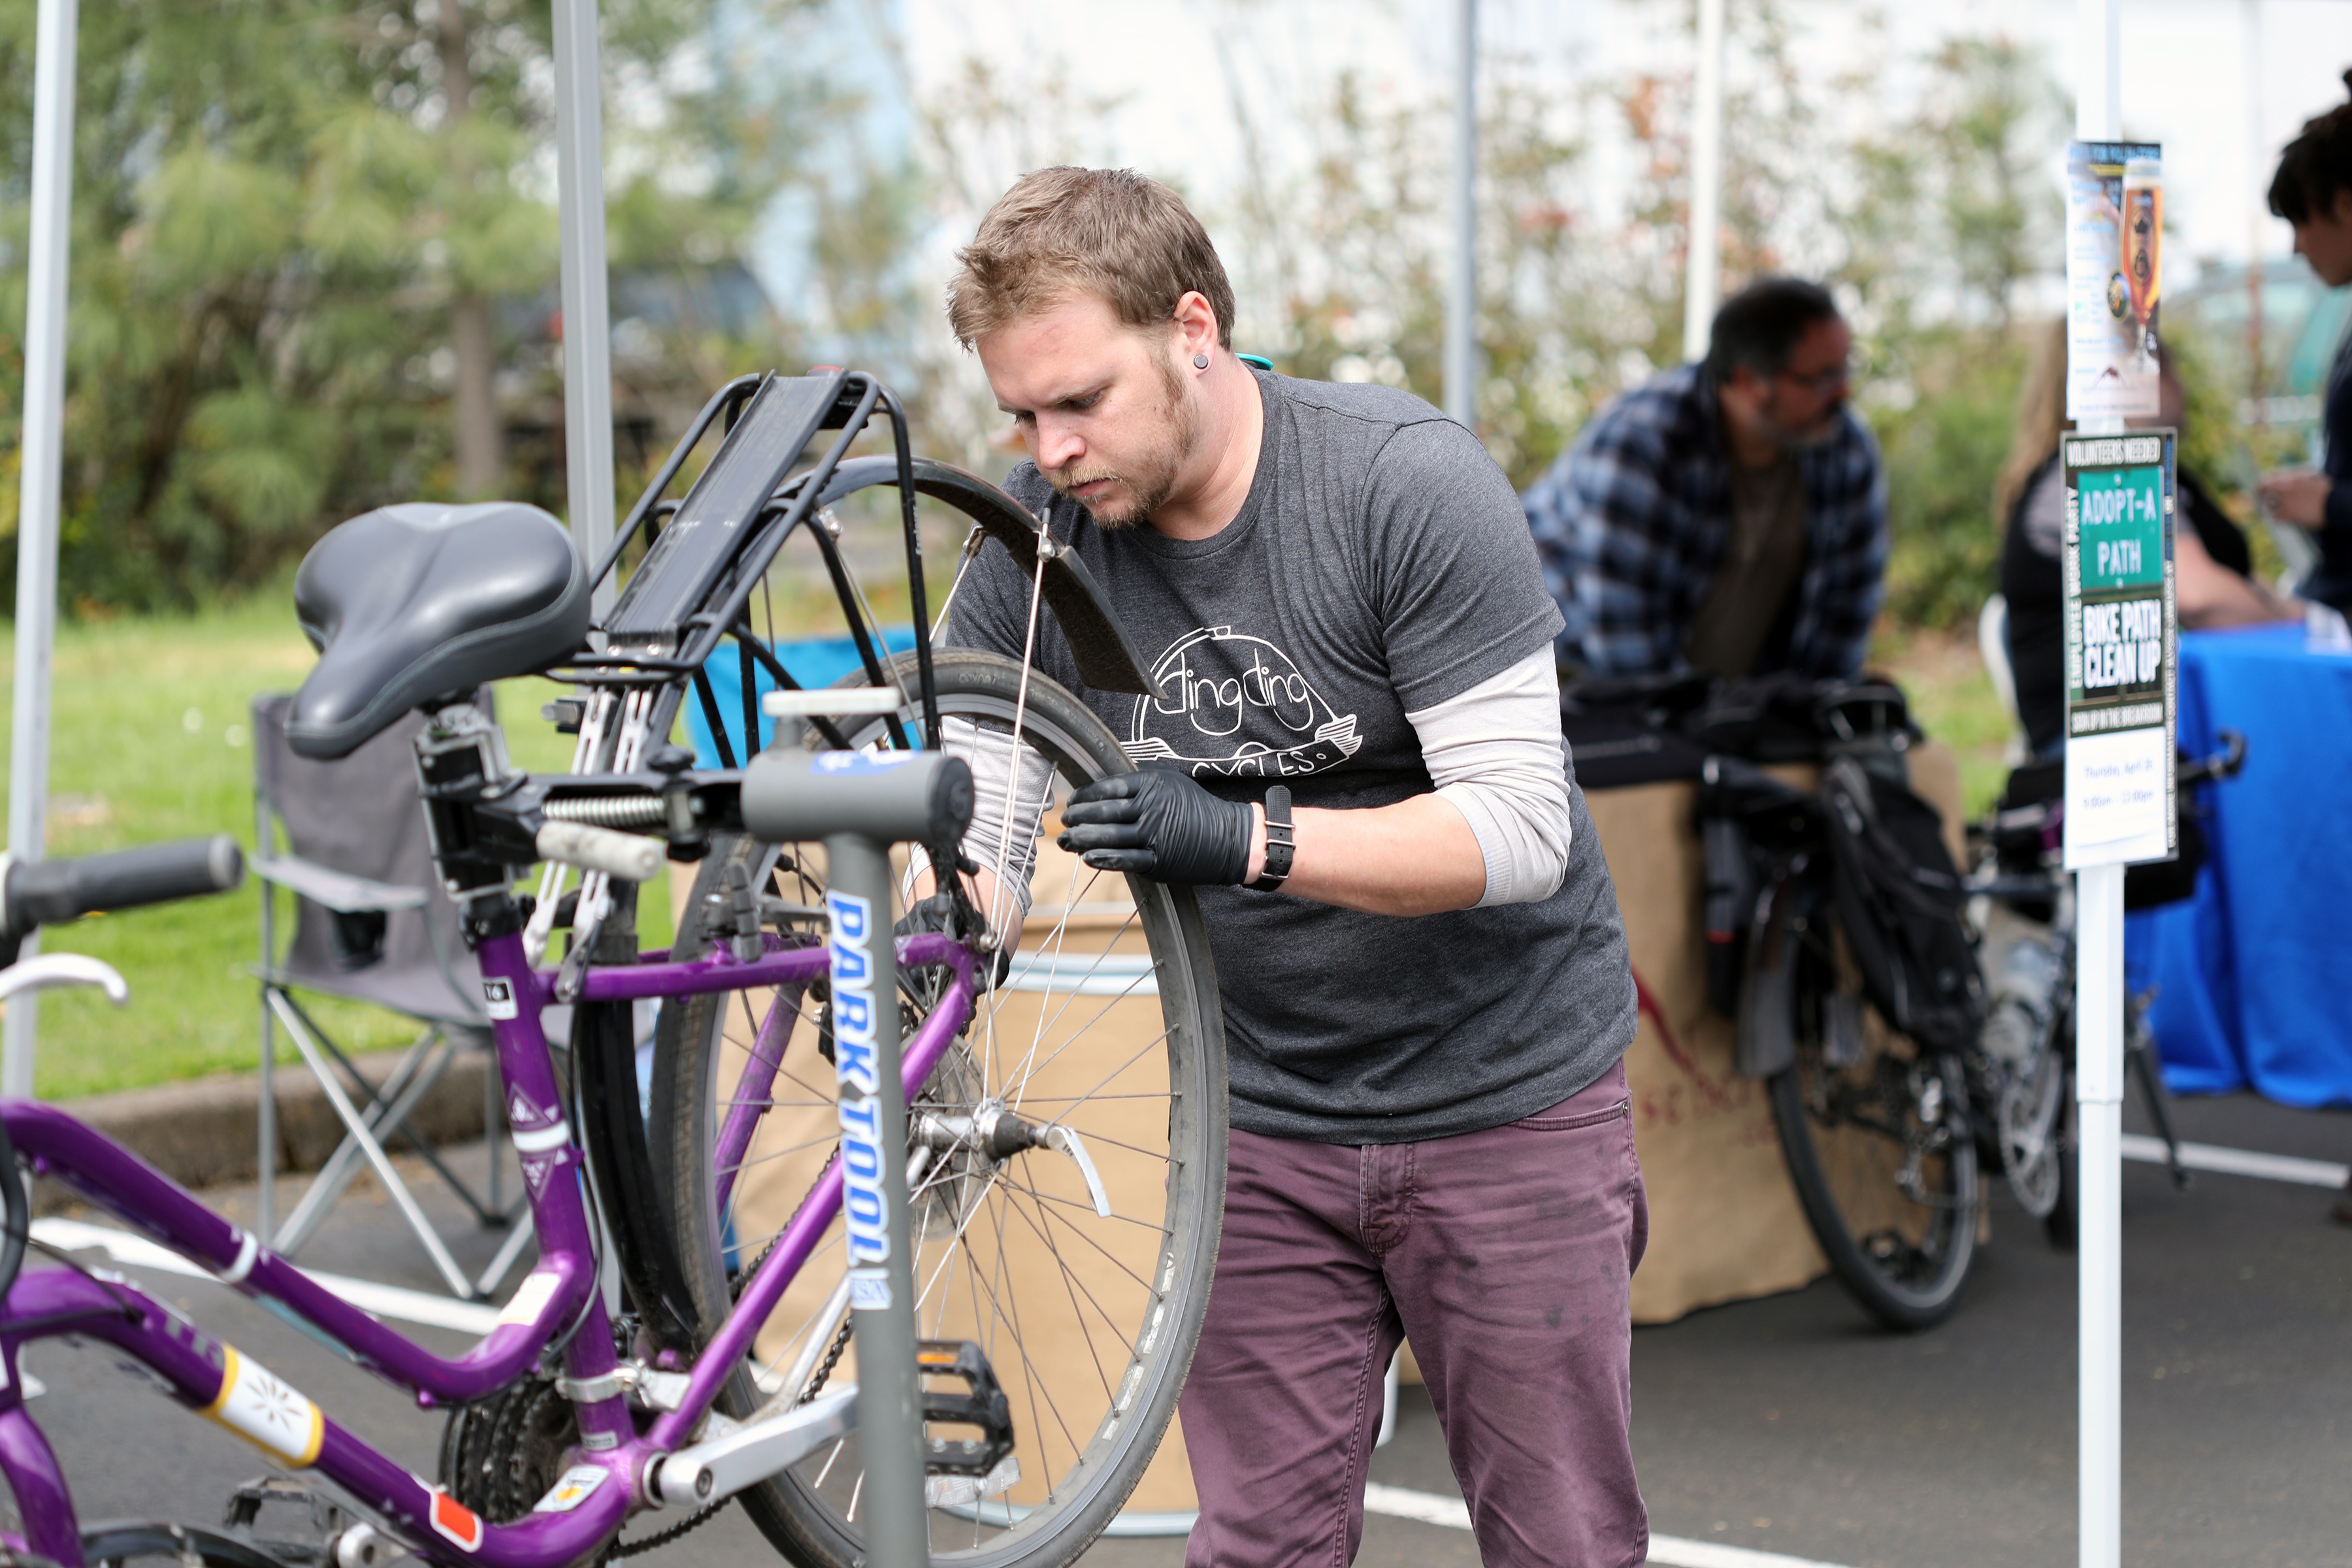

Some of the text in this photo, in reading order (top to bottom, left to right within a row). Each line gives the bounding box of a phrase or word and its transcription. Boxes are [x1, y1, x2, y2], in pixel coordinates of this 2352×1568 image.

[2067, 437, 2161, 467] VOLUNTEERS NEEDED
[2082, 487, 2157, 525] ADOPT-A
[2097, 539, 2142, 576] PATH
[2066, 487, 2083, 689] EMPLOYEE WORK PARTY
[2083, 599, 2162, 647] BIKE PATH
[2083, 640, 2162, 689] CLEAN UP
[826, 890, 890, 1266] PARK TOOL
